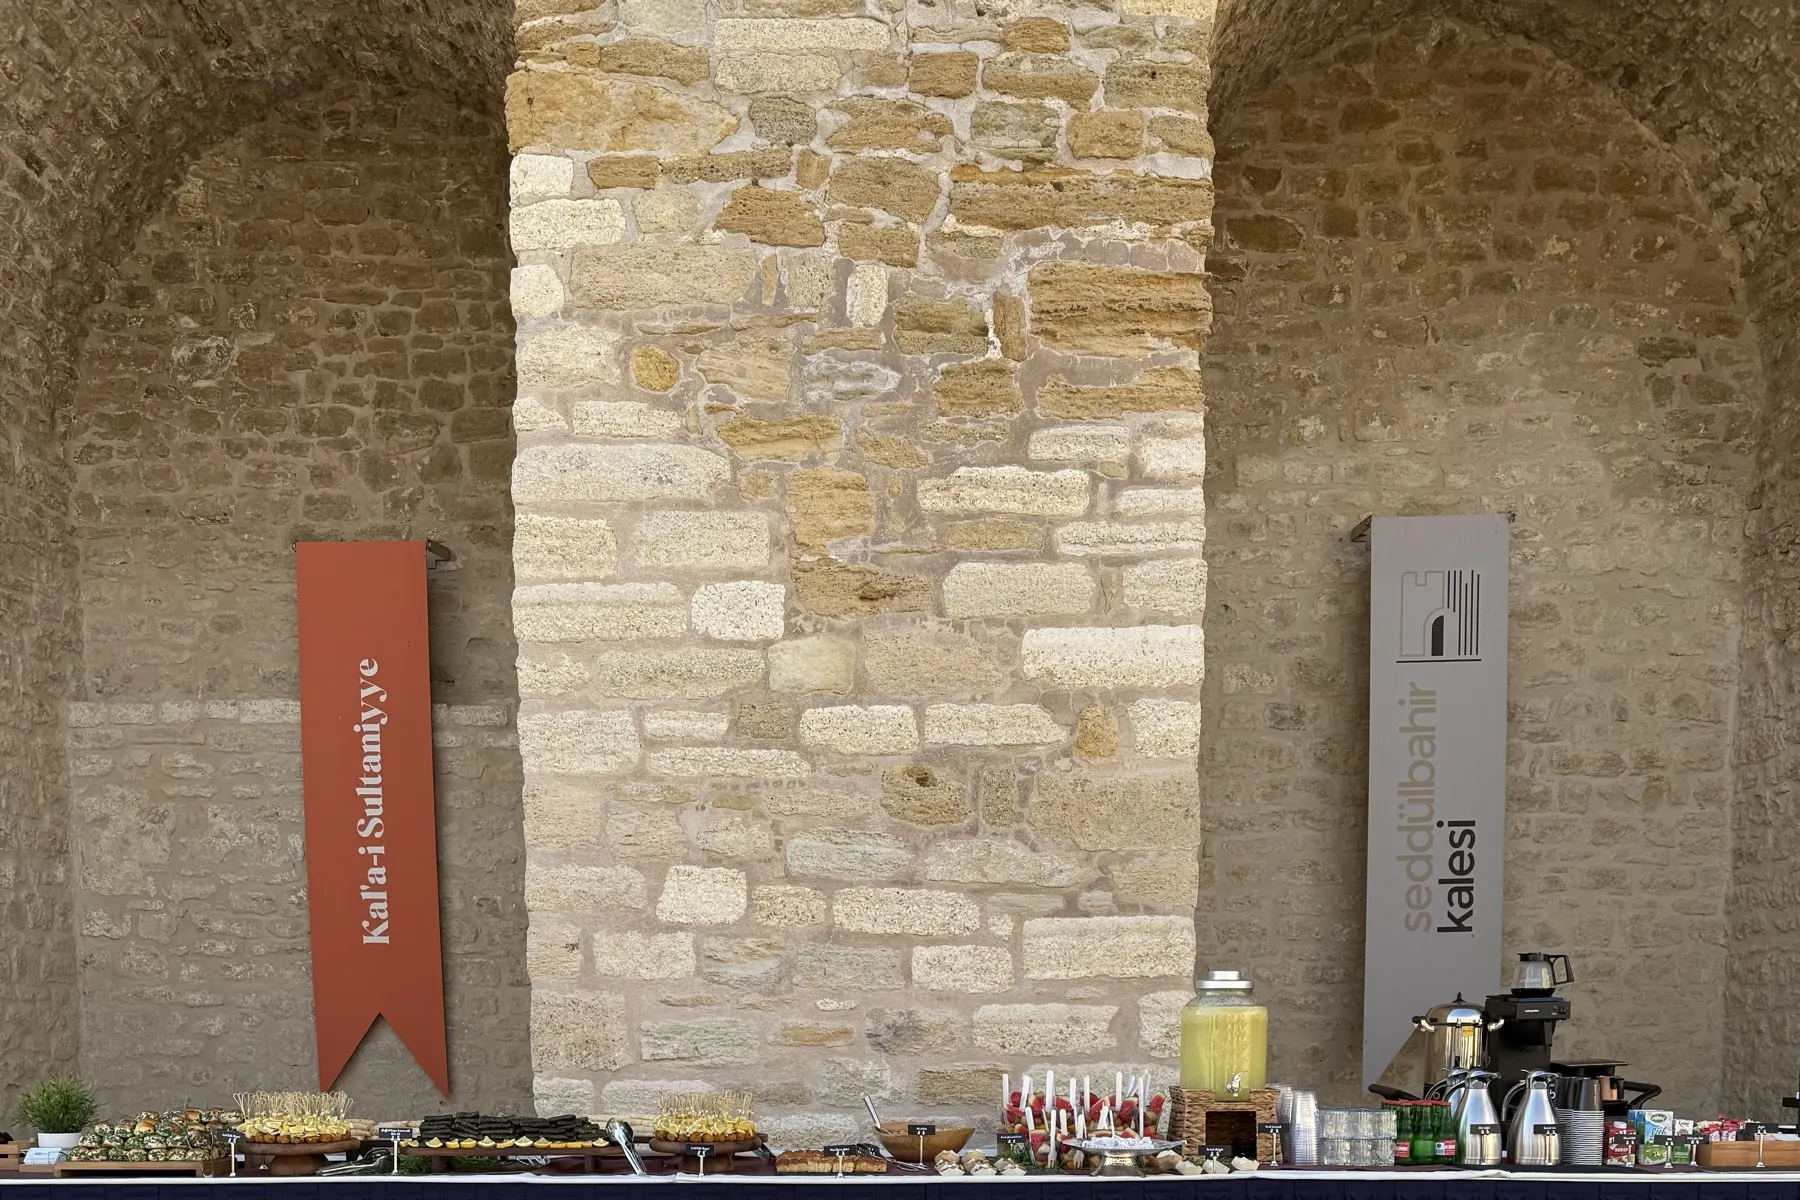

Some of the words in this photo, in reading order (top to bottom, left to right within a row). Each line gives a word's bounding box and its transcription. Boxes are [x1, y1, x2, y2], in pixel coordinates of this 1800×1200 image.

[353, 658, 388, 839] Sultaniyye
[1396, 682, 1438, 932] seddülbahir
[358, 844, 390, 945] Kal'a-i
[1436, 819, 1476, 933] kalesi
